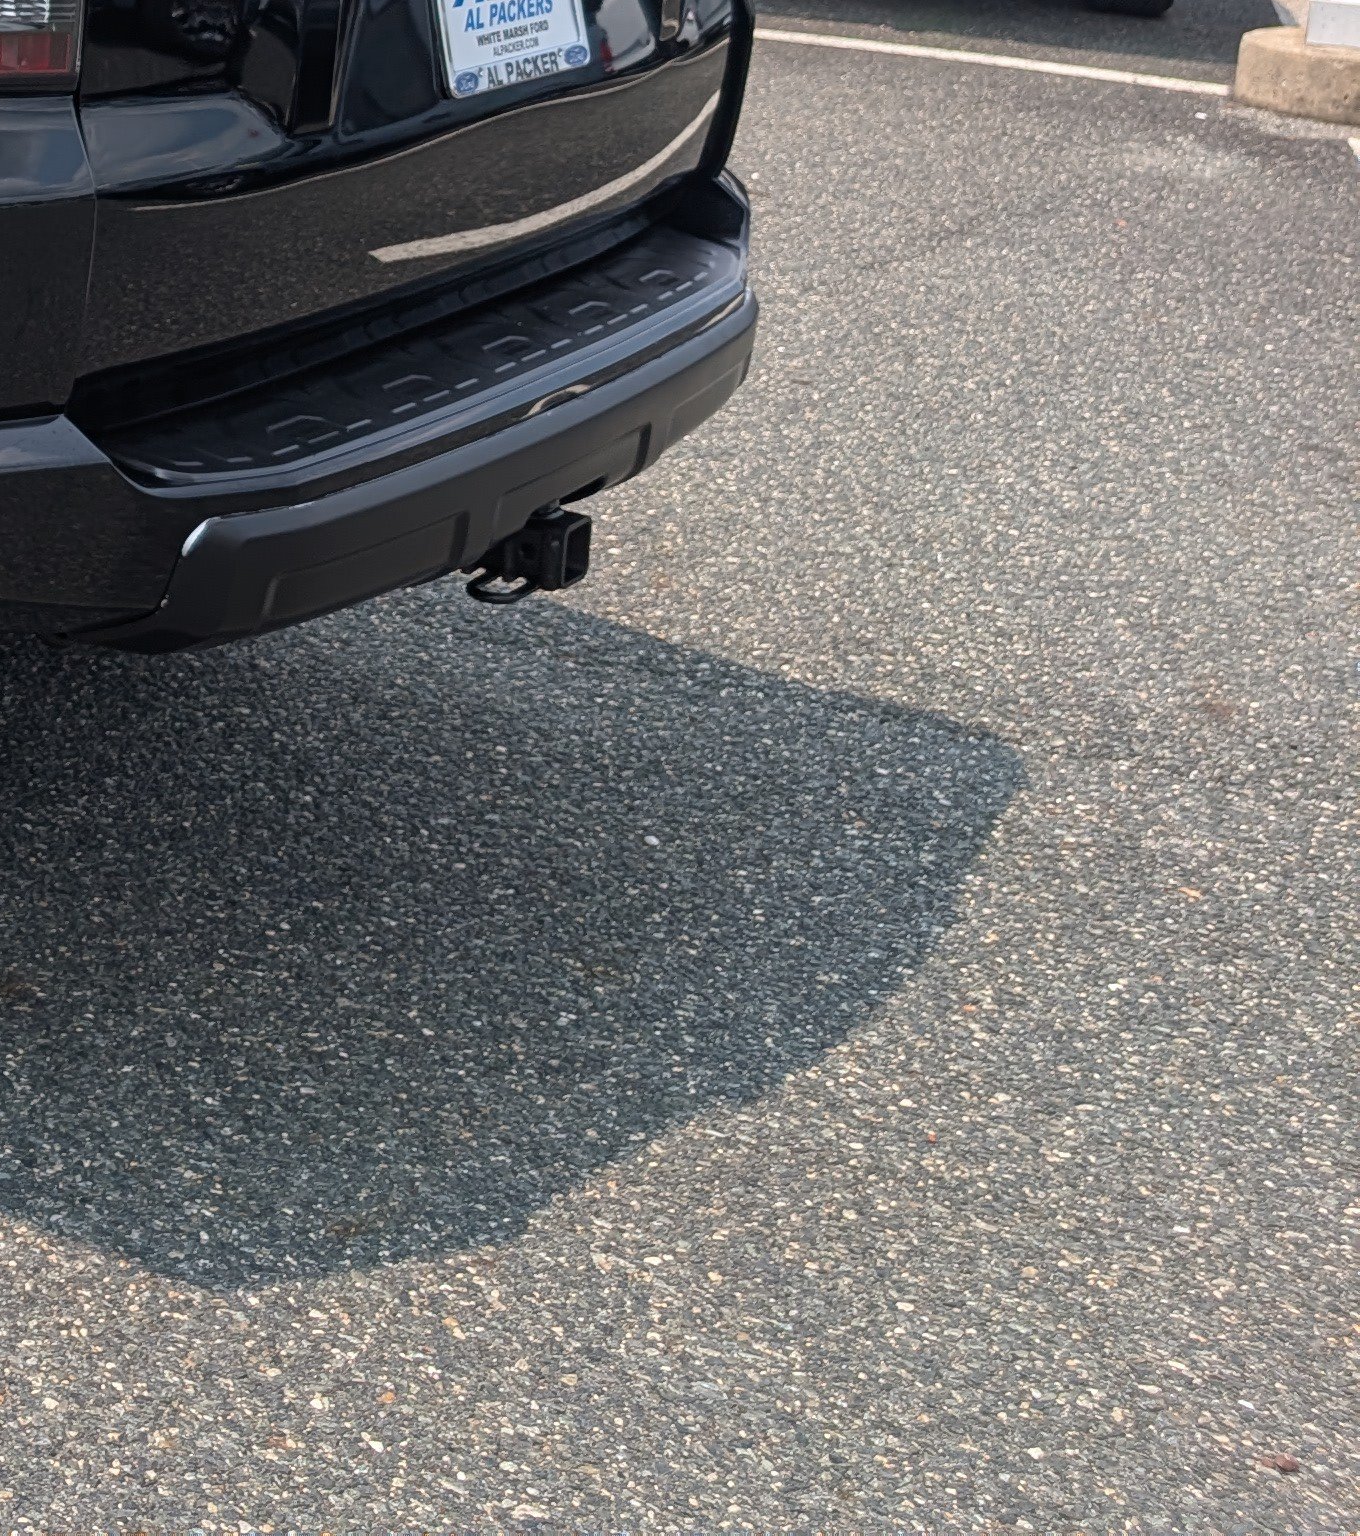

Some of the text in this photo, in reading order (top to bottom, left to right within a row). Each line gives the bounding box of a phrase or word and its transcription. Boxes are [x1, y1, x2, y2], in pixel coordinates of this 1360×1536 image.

[464, 8, 485, 32] AL
[476, 19, 549, 46] WHITE MARSH FORD
[487, 65, 503, 88] AL
[505, 51, 560, 83] PACKER
